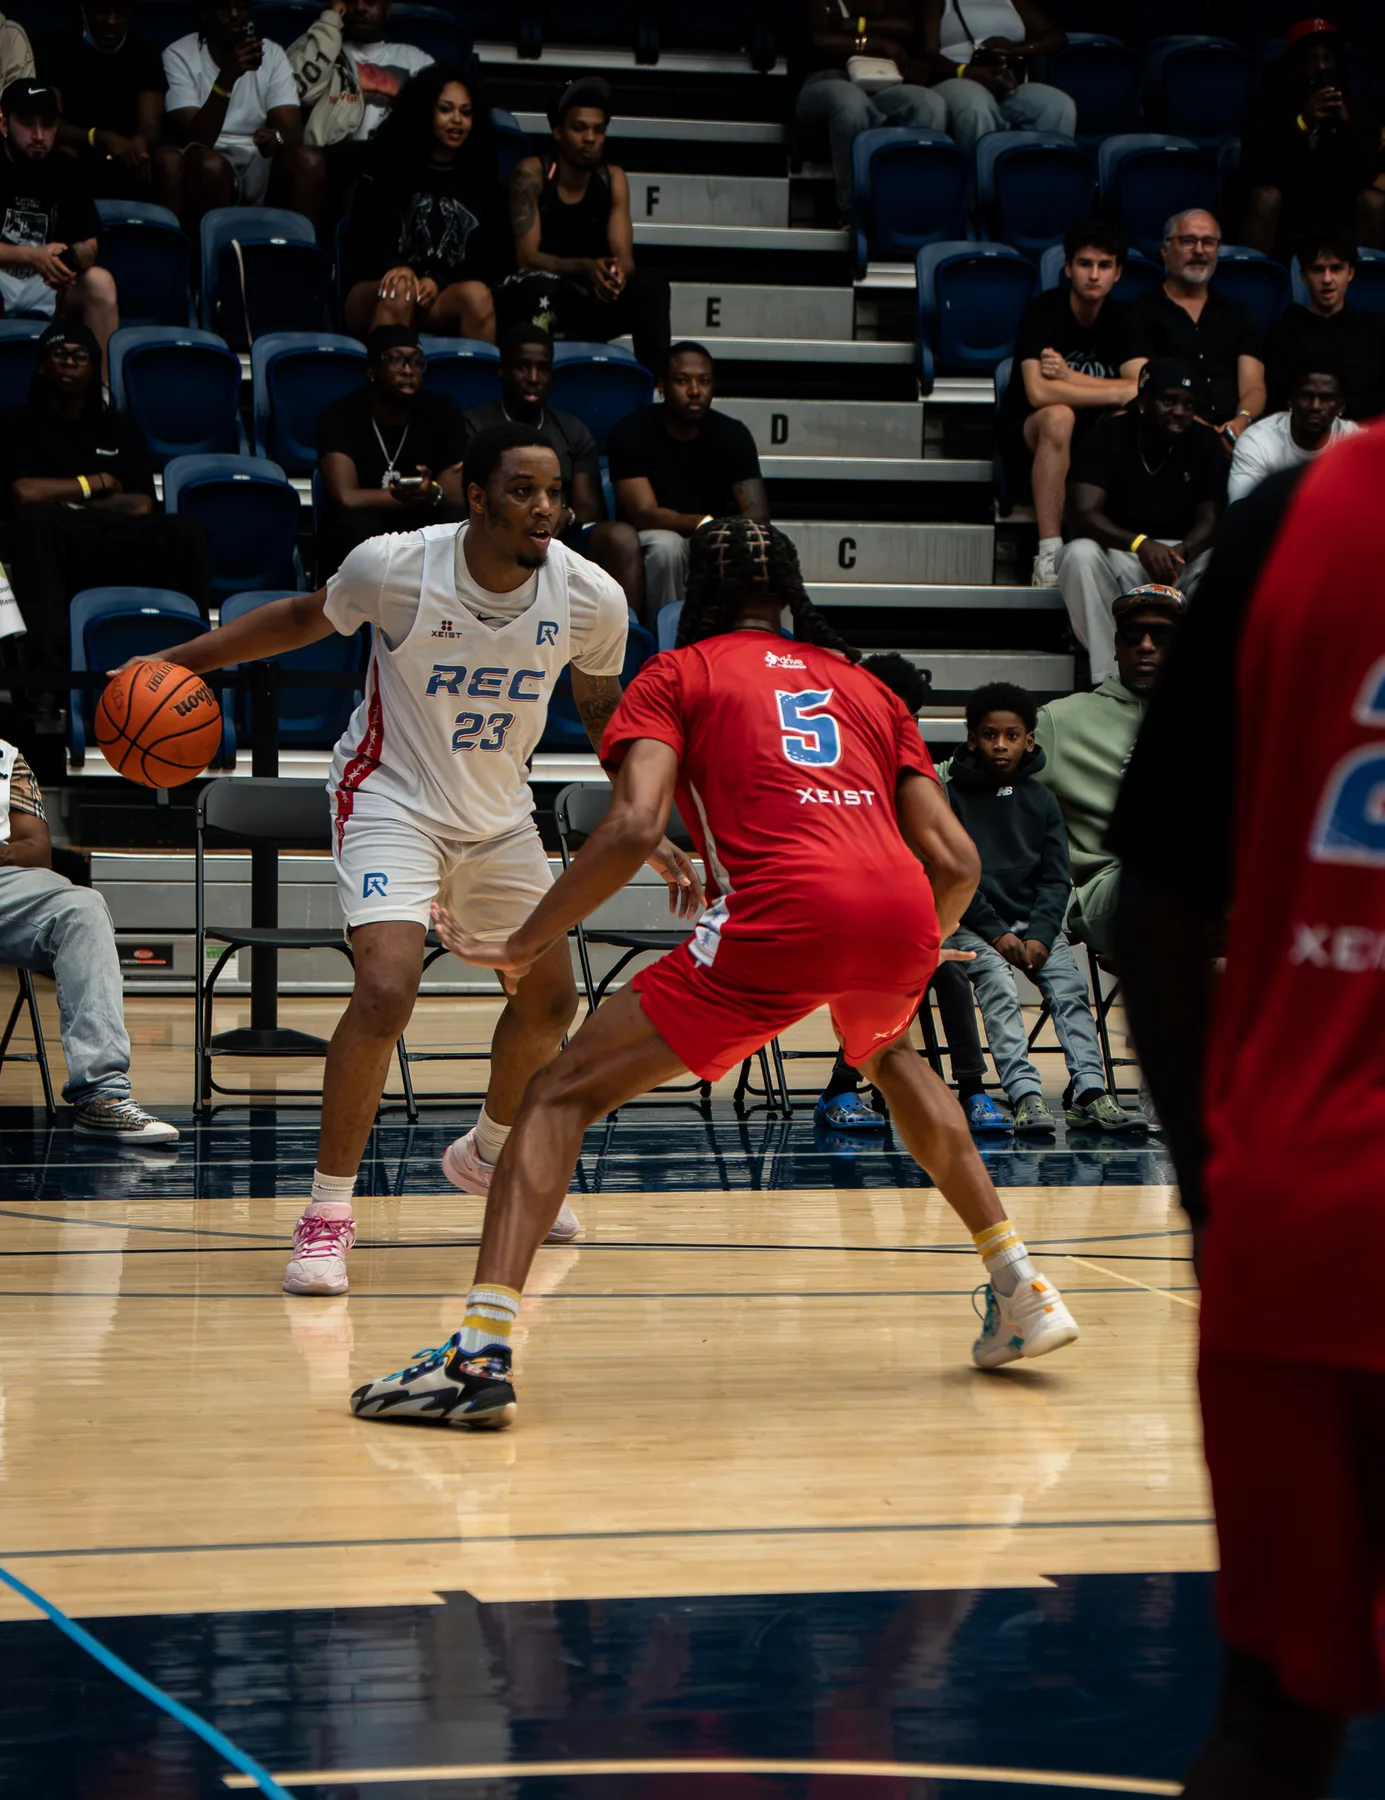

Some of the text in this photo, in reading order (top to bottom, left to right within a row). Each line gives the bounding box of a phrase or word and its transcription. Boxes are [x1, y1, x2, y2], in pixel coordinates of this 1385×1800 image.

[646, 185, 660, 216] F
[706, 297, 721, 327] E
[771, 413, 788, 445] D
[838, 537, 856, 569] C
[431, 630, 462, 639] XEIST
[424, 664, 547, 703] REC
[451, 711, 516, 755] 23
[774, 688, 842, 768] 5
[795, 787, 875, 806] XEIST
